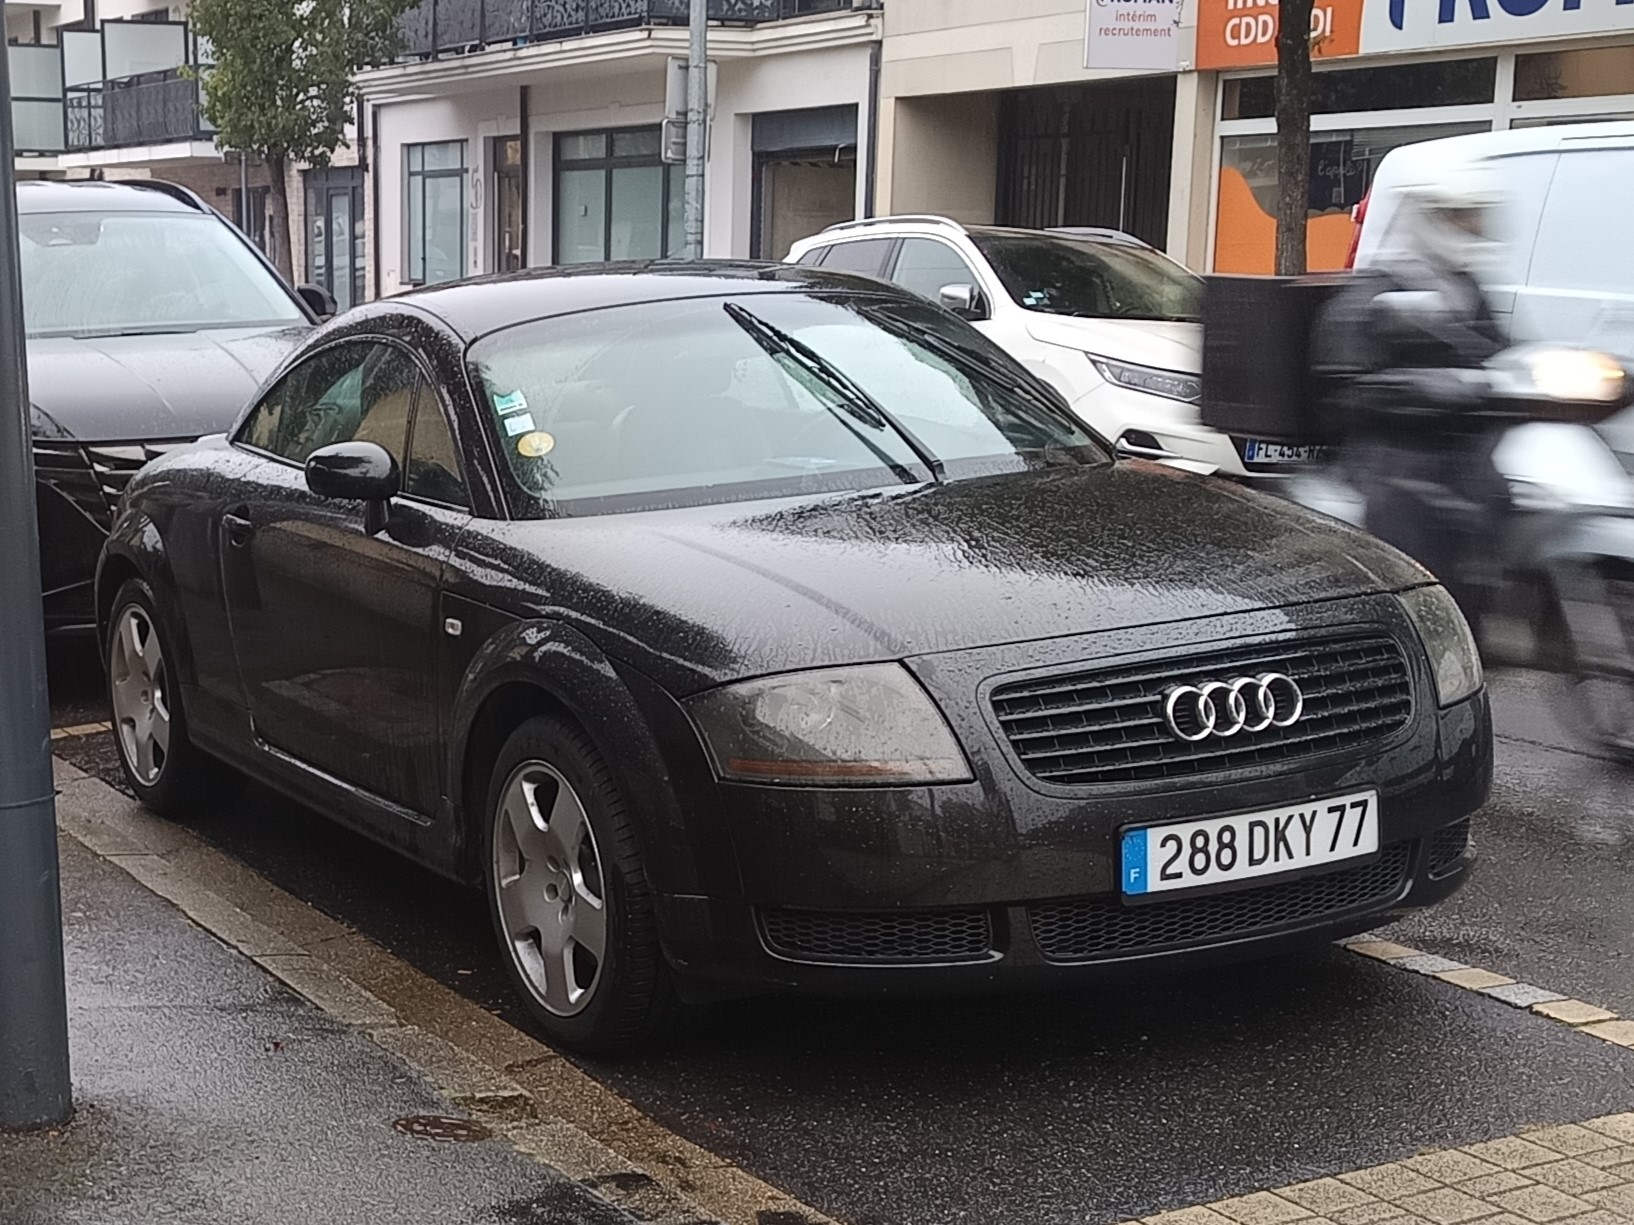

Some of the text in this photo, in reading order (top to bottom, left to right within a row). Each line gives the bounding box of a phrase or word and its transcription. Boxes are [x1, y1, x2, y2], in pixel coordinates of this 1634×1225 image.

[1115, 10, 1157, 22] intérim
[1099, 26, 1172, 37] recrutement
[1225, 14, 1274, 46] CDD
[1129, 799, 1369, 883] F 288 DKY 77
